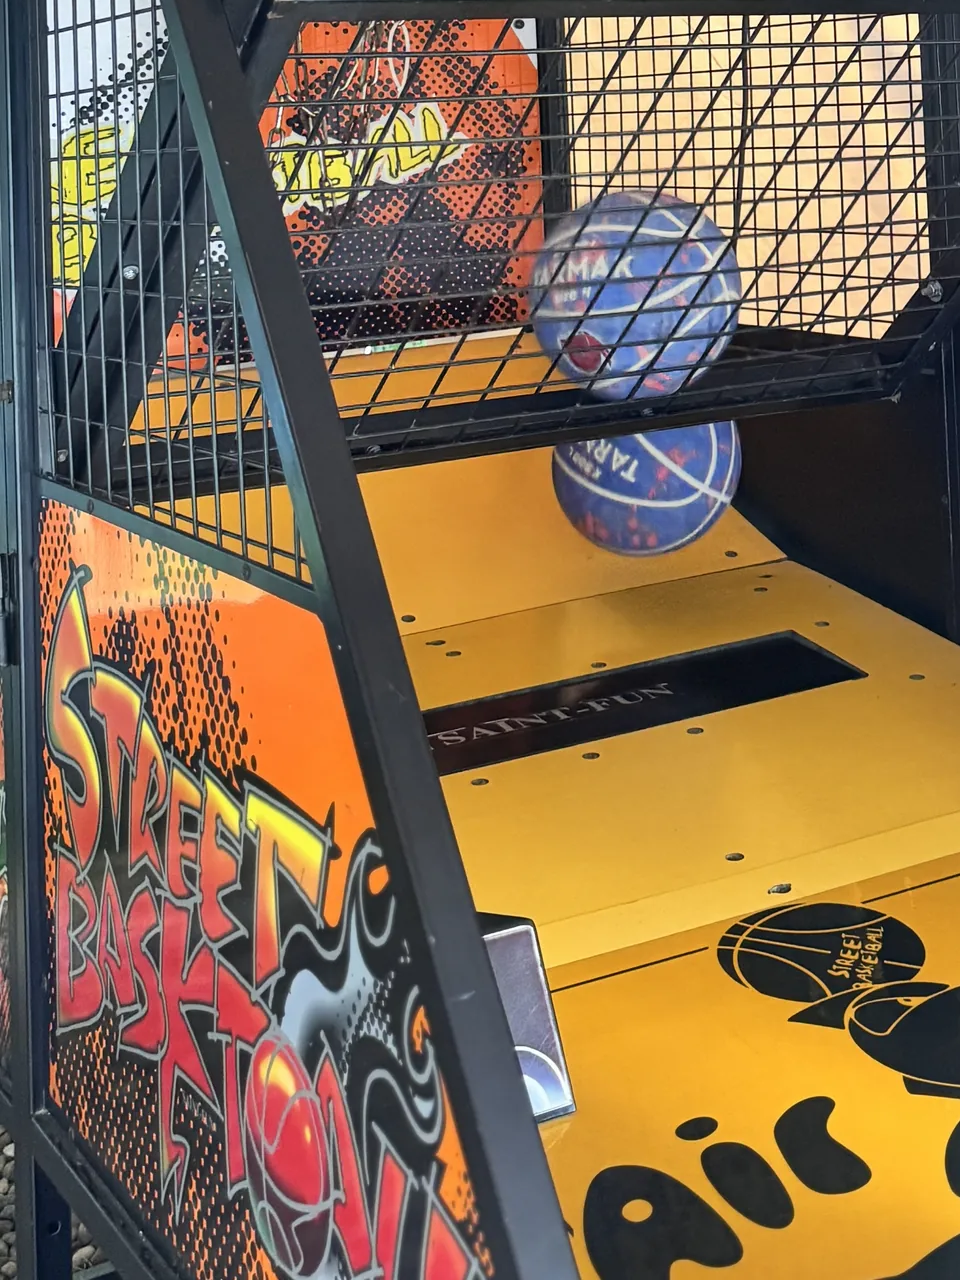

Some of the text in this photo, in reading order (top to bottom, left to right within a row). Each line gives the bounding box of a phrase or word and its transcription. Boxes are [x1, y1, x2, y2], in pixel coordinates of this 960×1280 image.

[45, 566, 338, 995] STREET
[827, 932, 862, 979] STREET
[852, 926, 884, 989] BASKETBALL
[583, 1096, 872, 1280] Air
